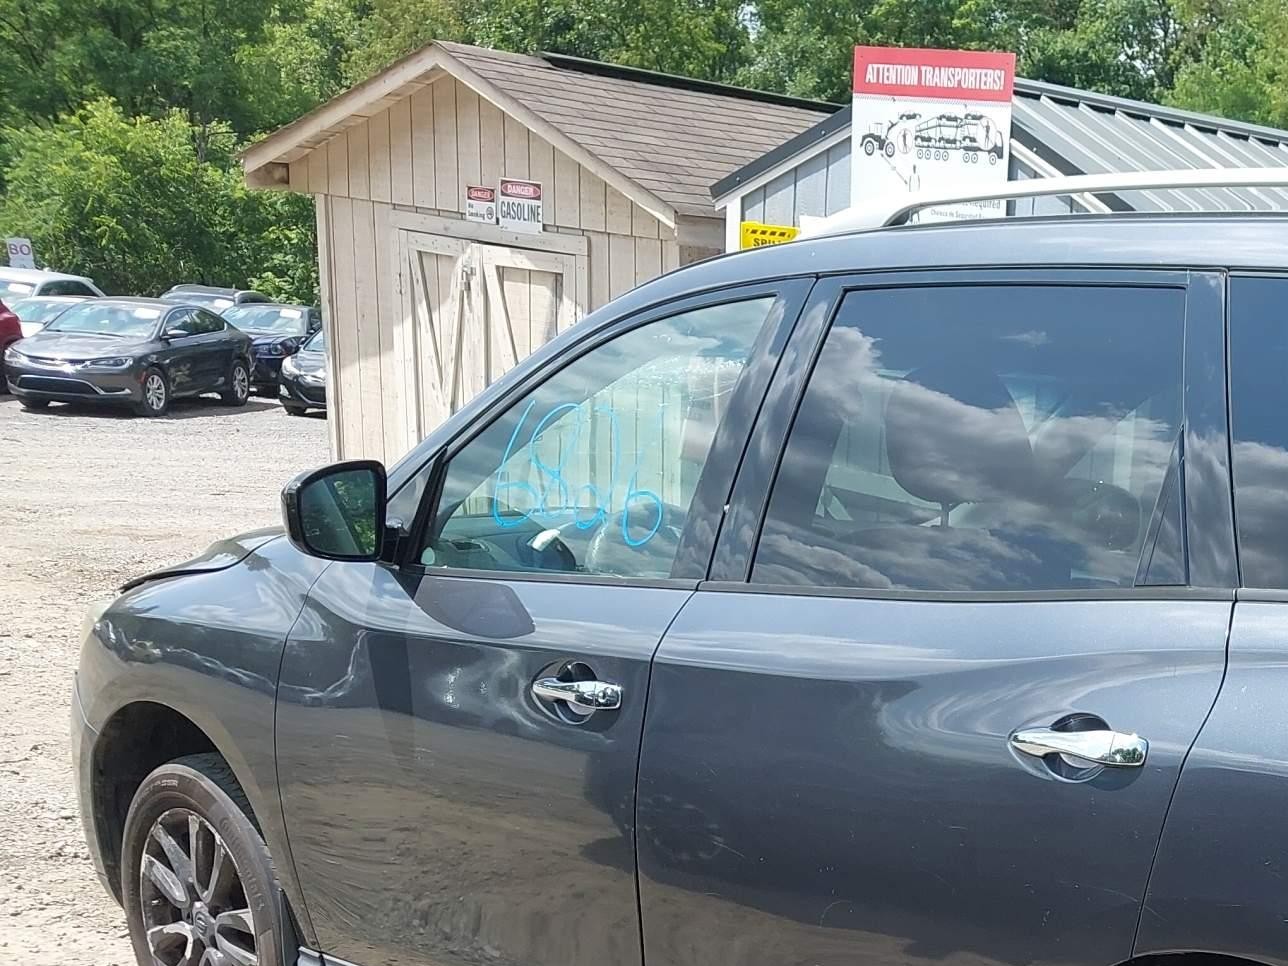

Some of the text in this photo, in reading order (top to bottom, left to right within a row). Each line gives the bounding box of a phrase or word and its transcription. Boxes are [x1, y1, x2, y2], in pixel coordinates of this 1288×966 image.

[865, 63, 1005, 90] ATTENTION TRANSPORTERS!
[507, 184, 534, 195] DANGER
[500, 201, 541, 223] GASOLINE
